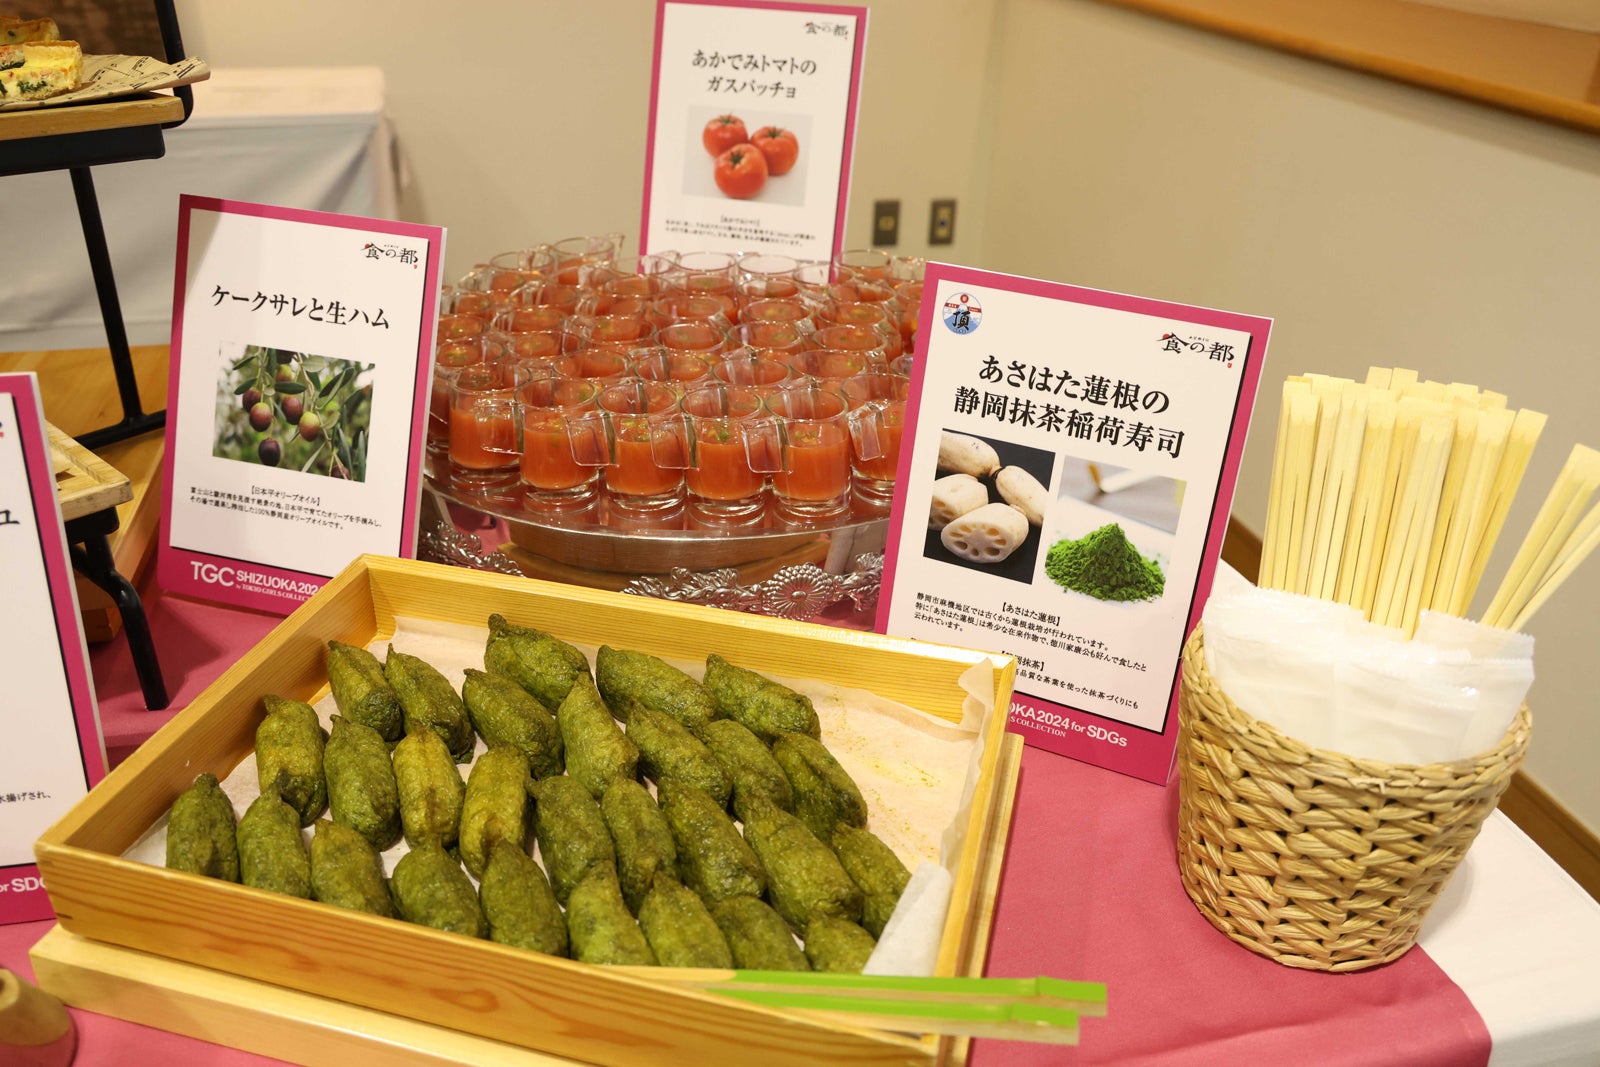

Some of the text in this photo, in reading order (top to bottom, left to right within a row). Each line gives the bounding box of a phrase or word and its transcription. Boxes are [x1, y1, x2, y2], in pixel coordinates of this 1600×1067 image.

[692, 49, 817, 75] あかでみトマトの
[361, 242, 418, 264] 食の都
[212, 284, 389, 329] ケークサレと生ハム
[952, 310, 971, 330] 頂
[1156, 332, 1234, 362] 食の都
[979, 355, 1170, 414] あさはた蓮根の
[954, 385, 1185, 459] 静岡抹茶稲荷寿司
[190, 560, 321, 596] TGC SHIZUOKA202
[1016, 717, 1066, 737] COLLECTION
[1070, 721, 1086, 733] for
[1086, 725, 1127, 747] SDGs
